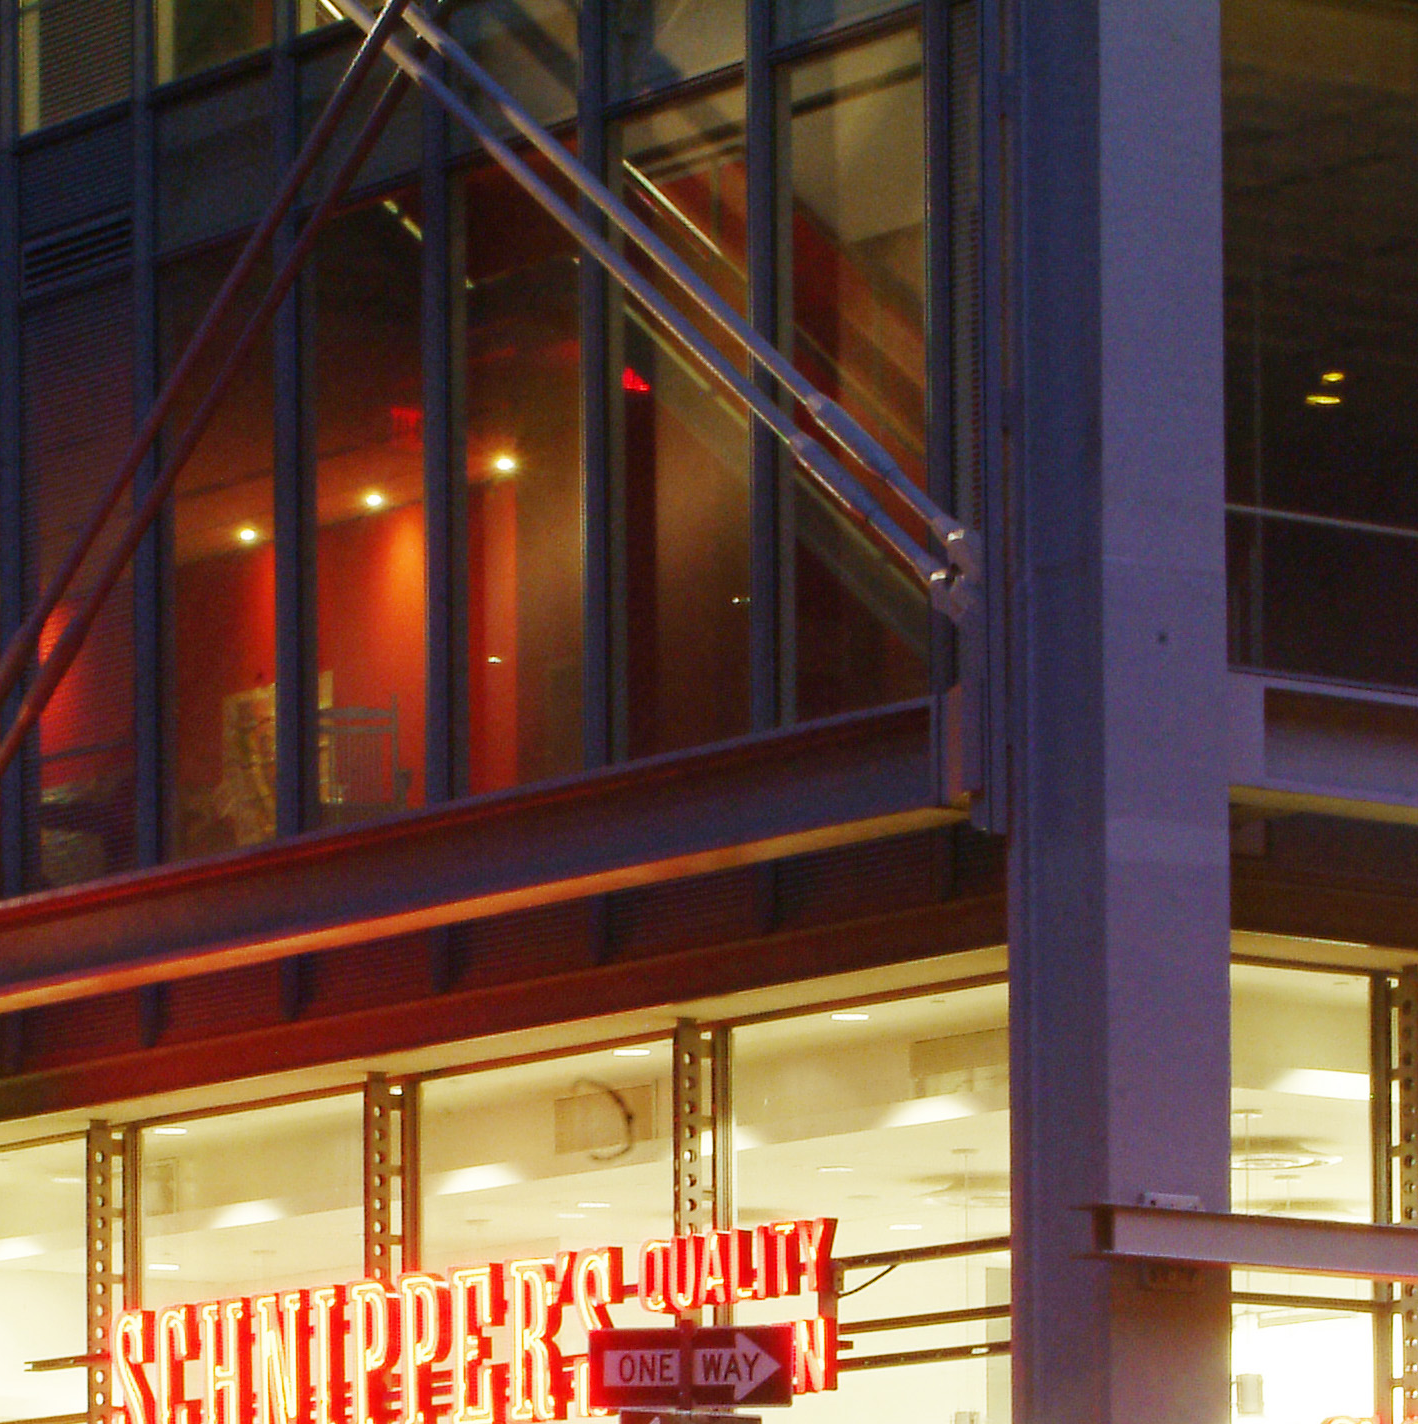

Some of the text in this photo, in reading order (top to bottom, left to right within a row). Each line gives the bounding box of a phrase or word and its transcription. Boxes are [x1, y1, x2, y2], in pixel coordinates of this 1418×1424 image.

[639, 1218, 837, 1314] QUALITY
[619, 1352, 761, 1383] ONE WAY
